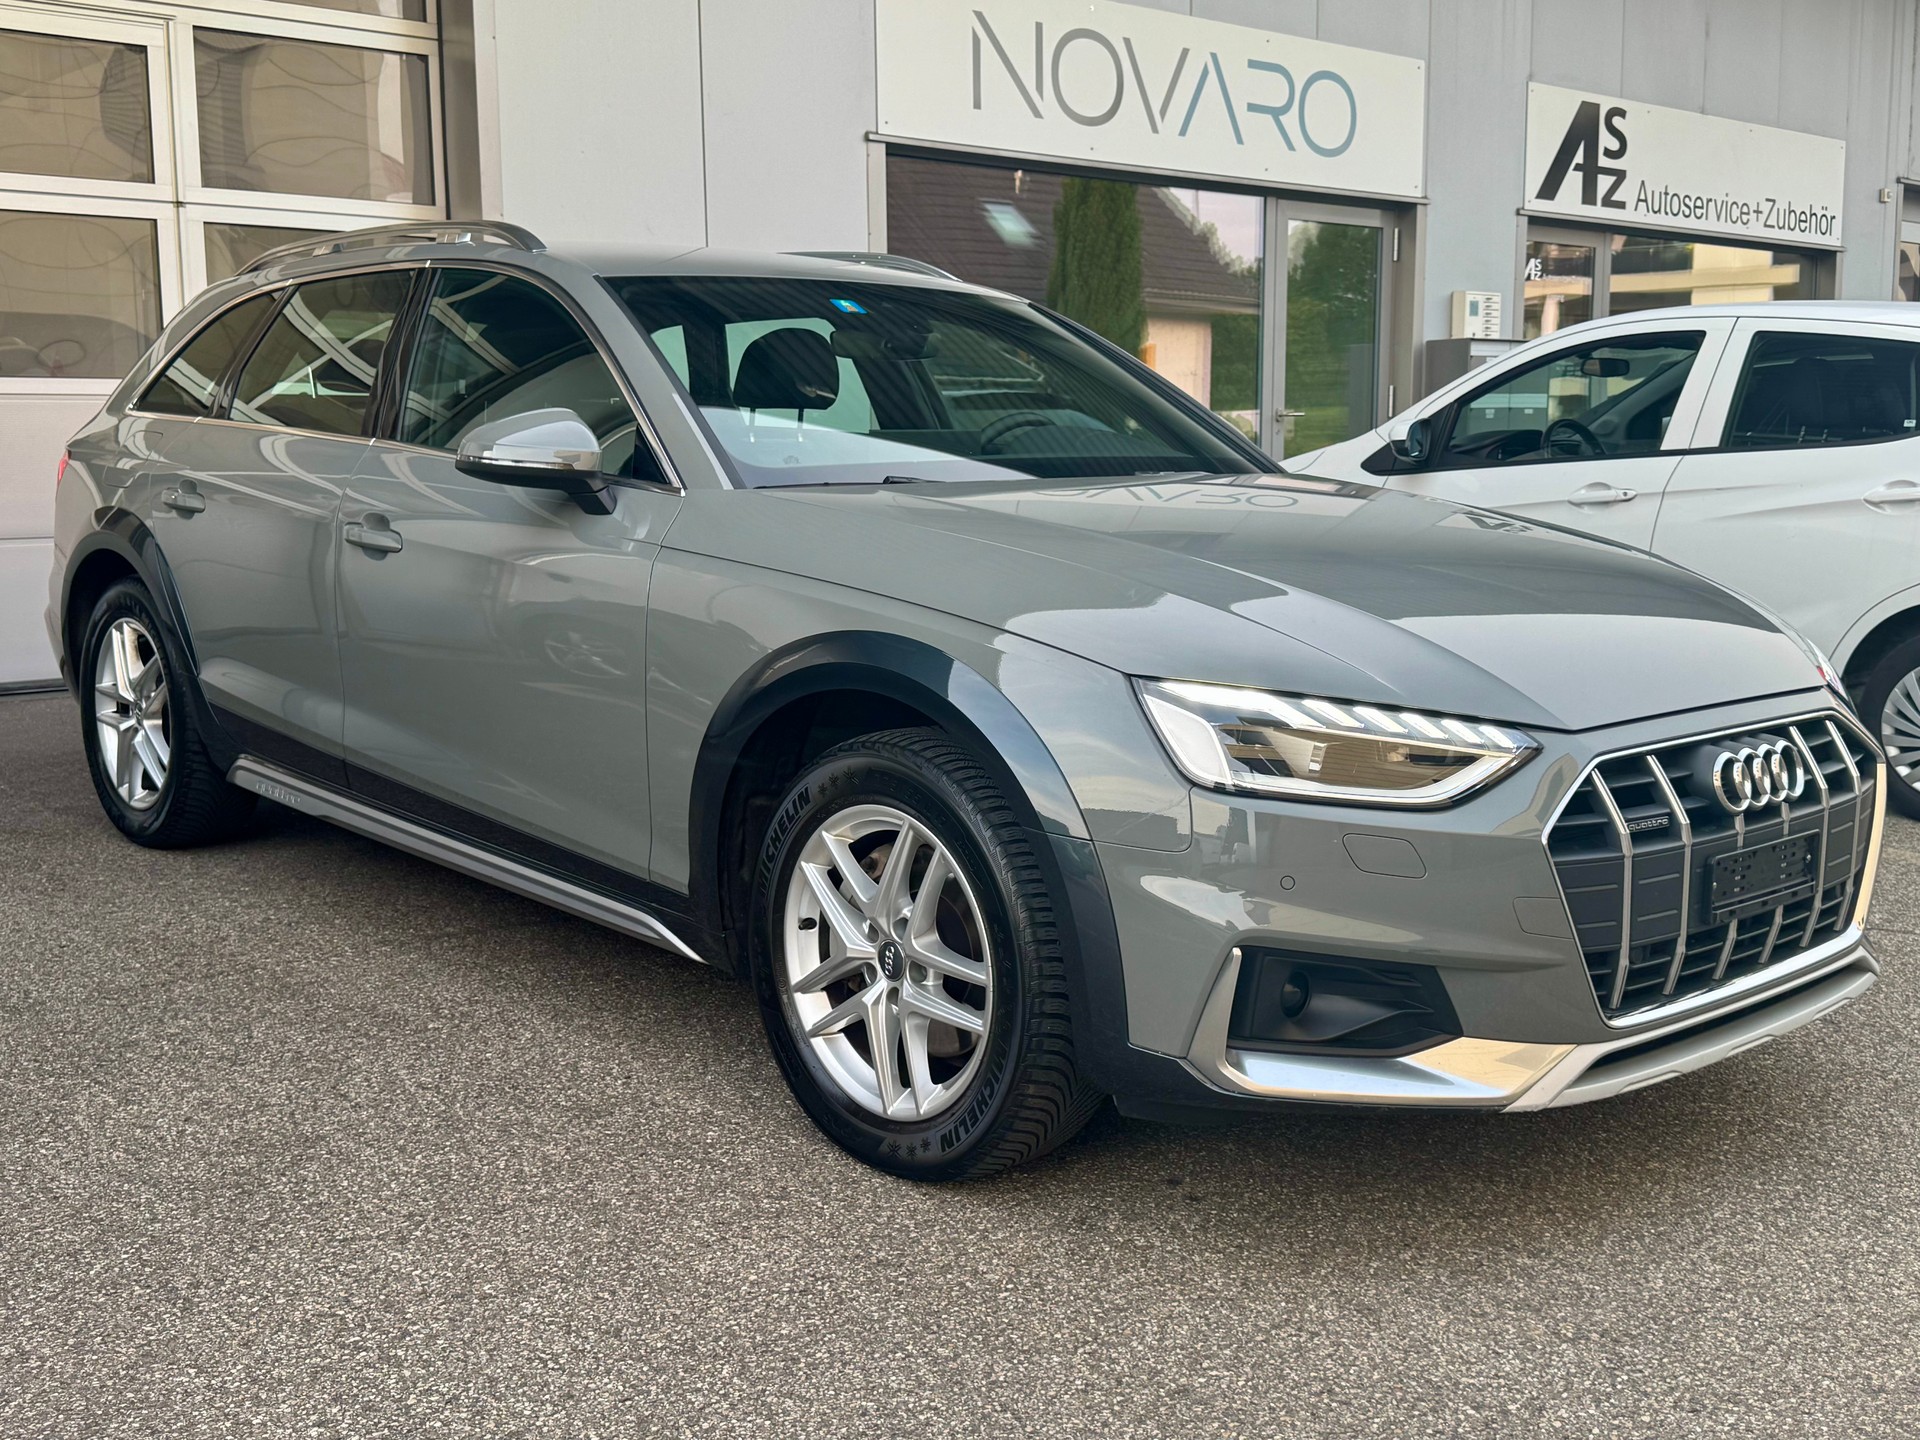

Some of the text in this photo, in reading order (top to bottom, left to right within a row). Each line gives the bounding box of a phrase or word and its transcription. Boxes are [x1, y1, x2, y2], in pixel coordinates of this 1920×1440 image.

[972, 10, 1357, 158] NOVARO
[1634, 180, 1836, 236] Autoservice+Zubehör
[760, 785, 811, 897] MICHELIN
[1629, 819, 1668, 831] quattro
[939, 1042, 1009, 1153] MICHELIN
